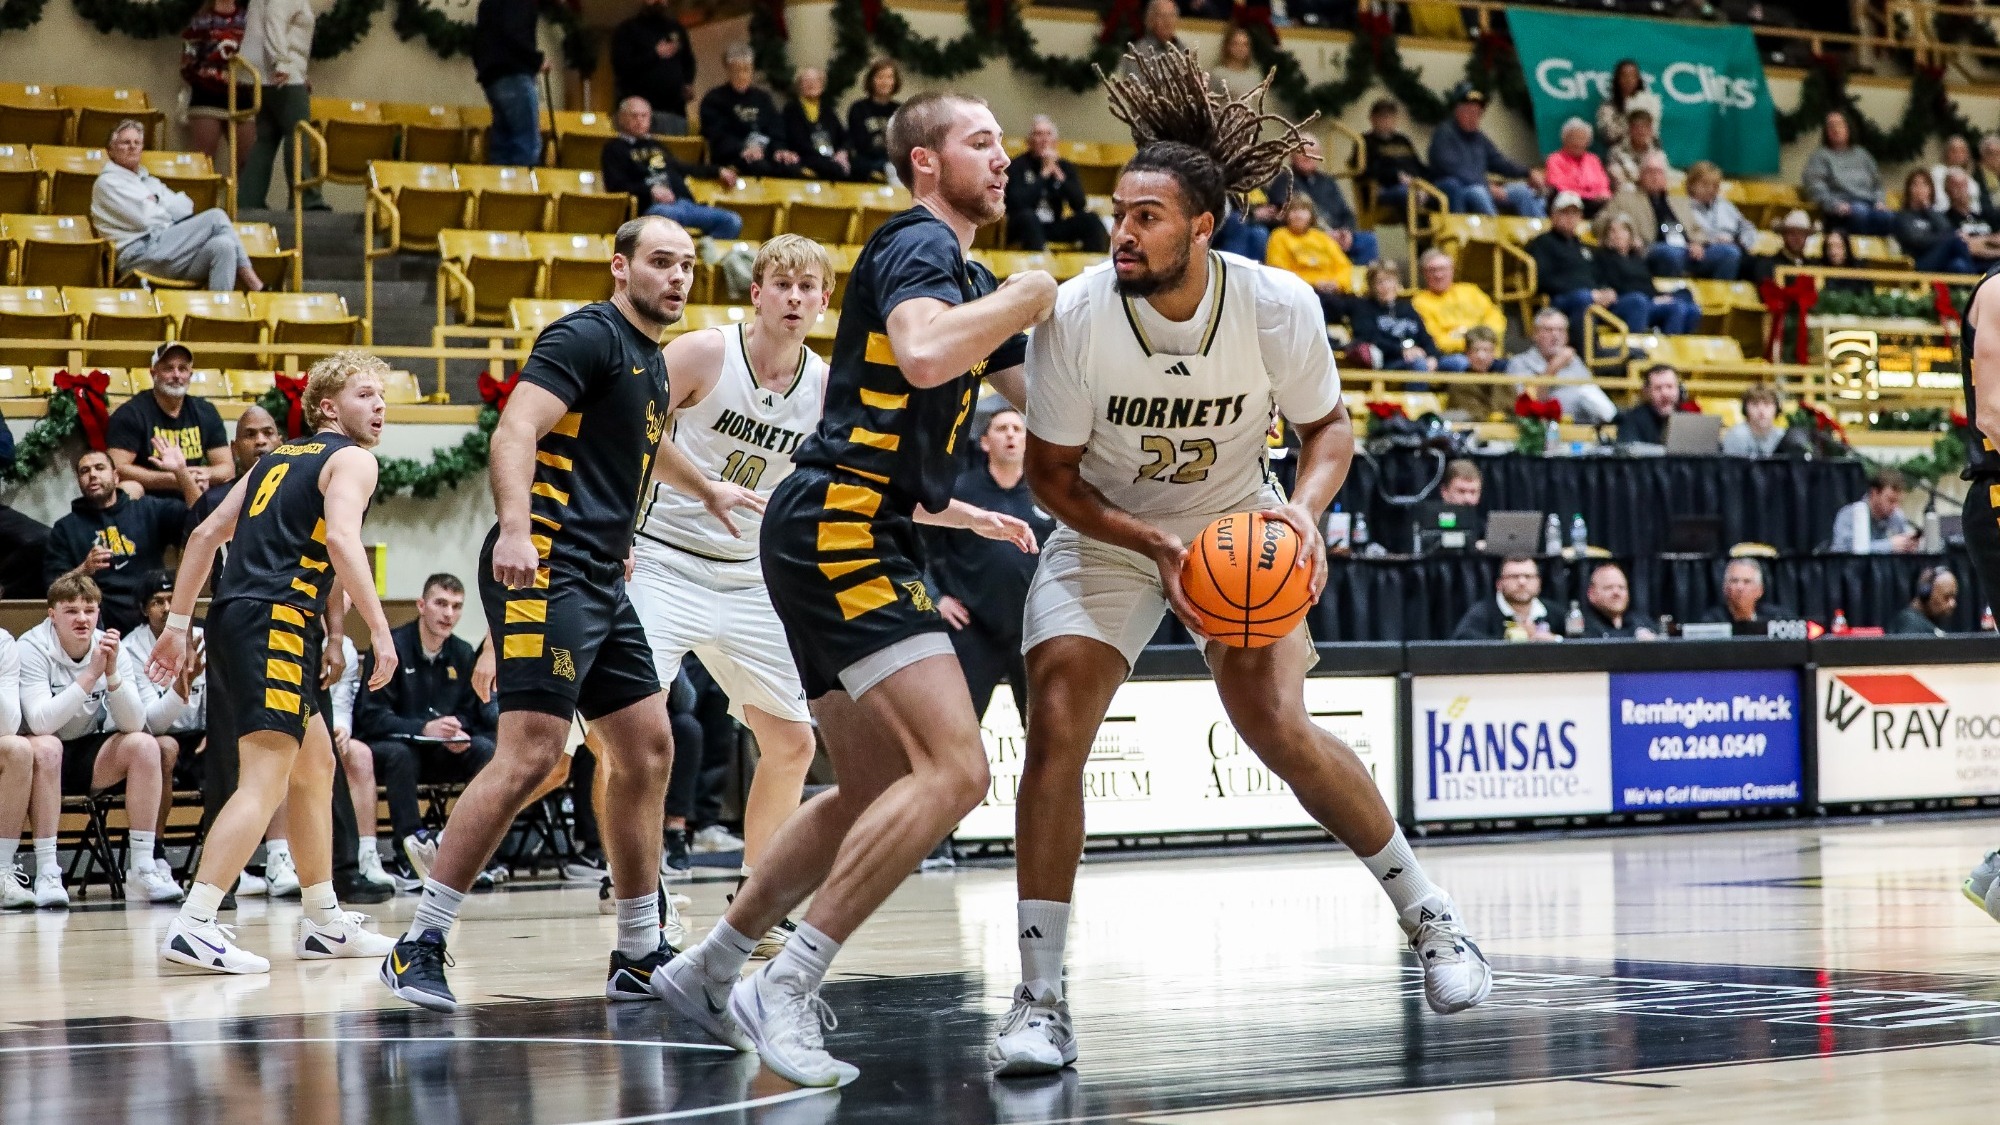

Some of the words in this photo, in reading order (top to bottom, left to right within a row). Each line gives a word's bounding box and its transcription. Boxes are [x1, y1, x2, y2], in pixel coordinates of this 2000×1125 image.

[1106, 393, 1249, 428] HORNETS
[720, 449, 767, 492] 10
[1132, 435, 1217, 484] 22
[248, 462, 290, 518] 8
[1767, 619, 1808, 640] POSS
[1621, 697, 1730, 729] Remington
[1426, 710, 1577, 775] KANSAS
[1649, 732, 1767, 761] 620.268.0549
[1664, 785, 1690, 804] Got
